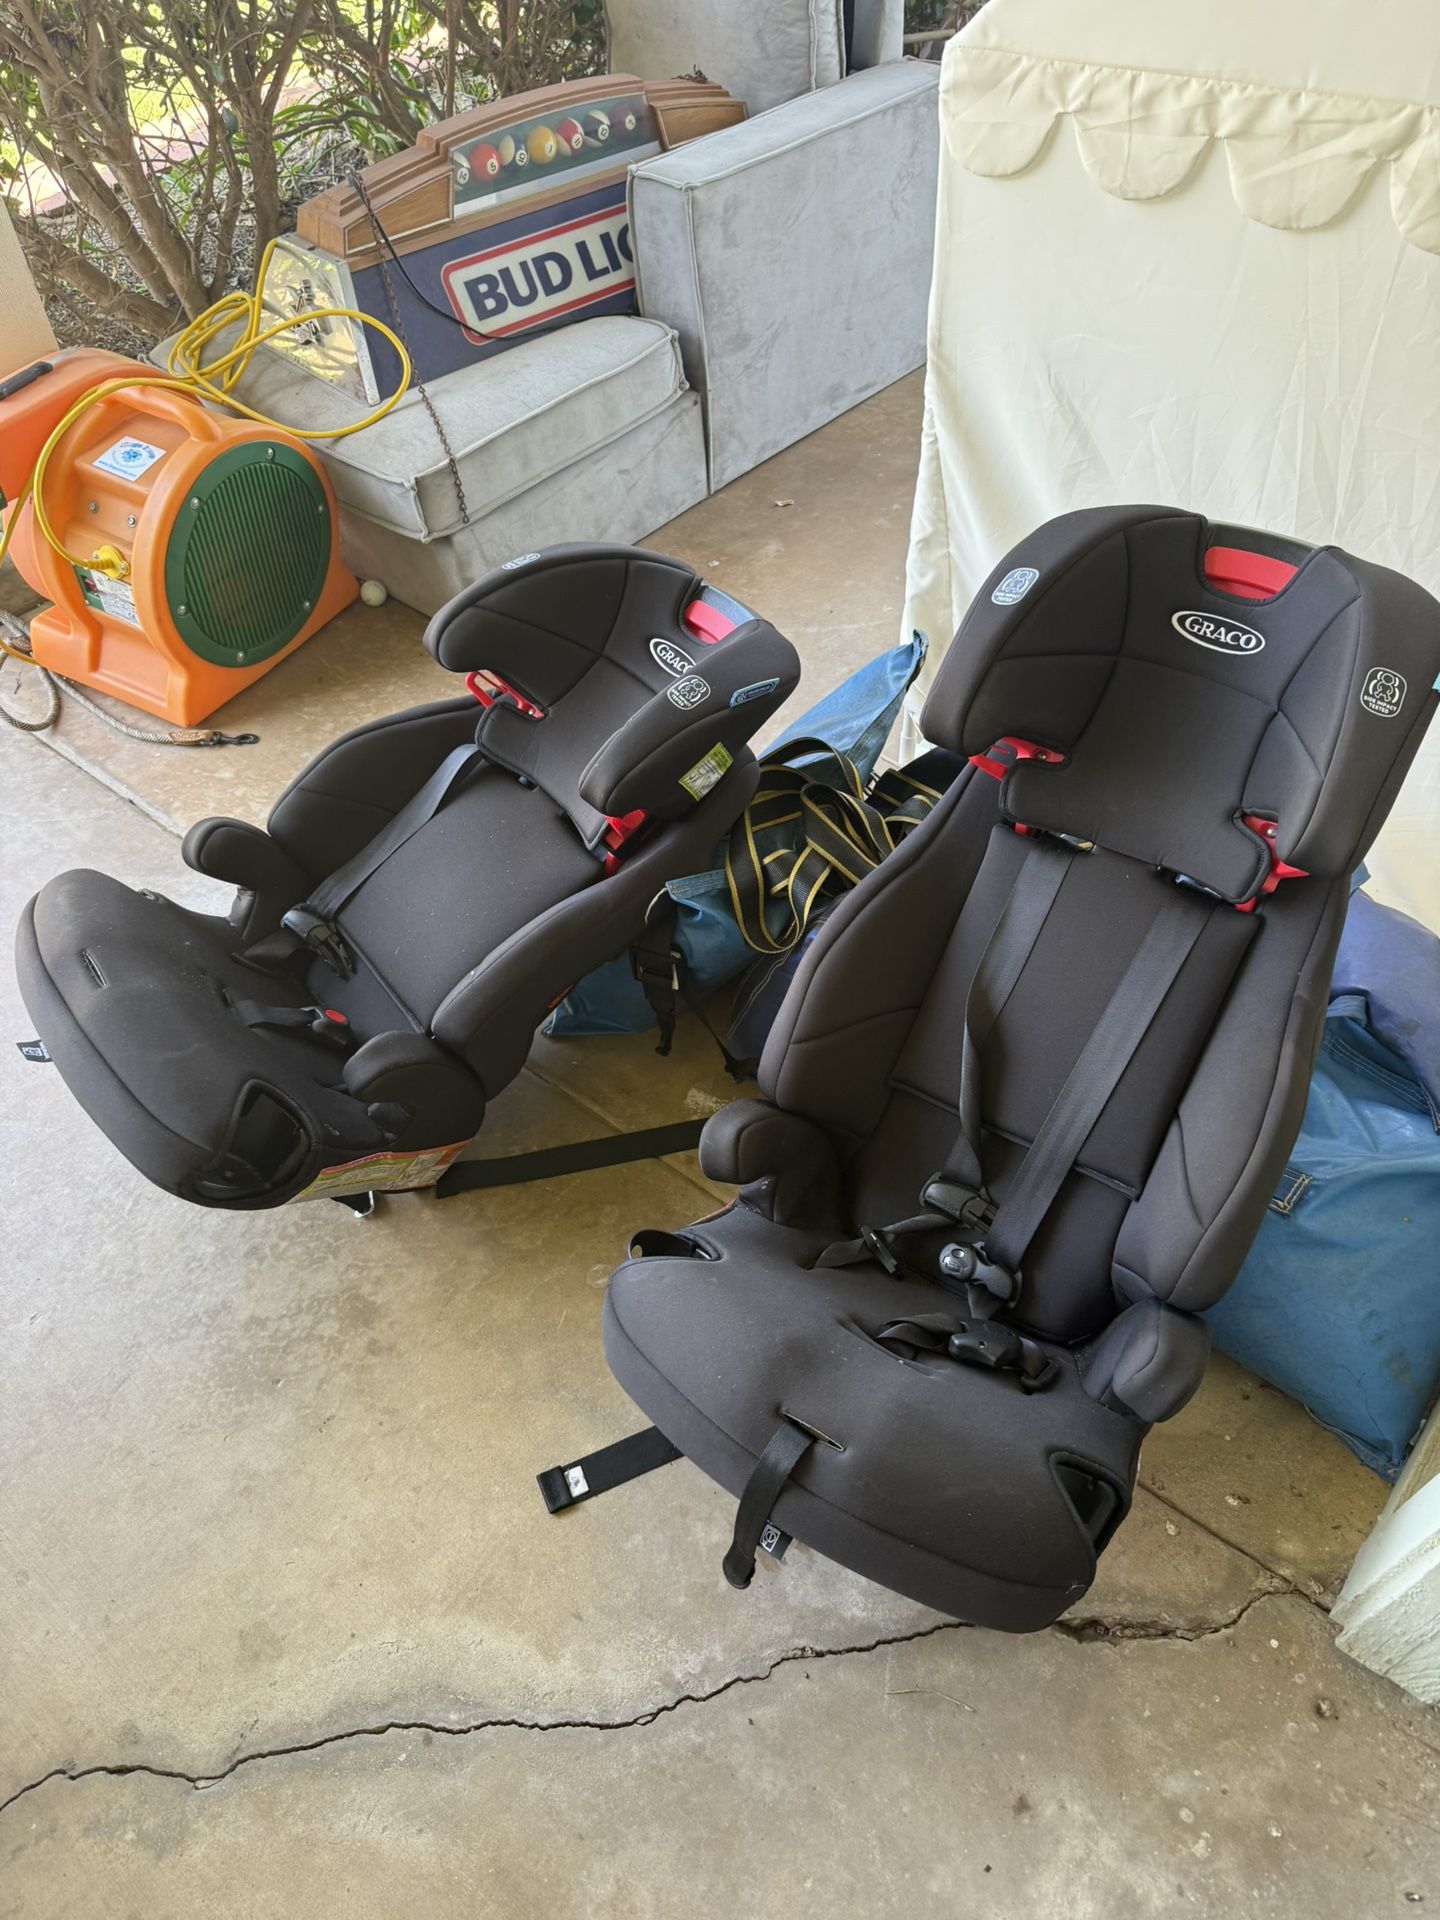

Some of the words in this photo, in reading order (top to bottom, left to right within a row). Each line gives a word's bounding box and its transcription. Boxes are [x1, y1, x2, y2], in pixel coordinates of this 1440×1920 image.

[600, 126, 608, 137] 12
[518, 152, 526, 163] 10
[458, 171, 467, 181] 14
[464, 252, 573, 321] BUD
[1185, 616, 1257, 649] GRACO
[1363, 695, 1376, 704] SIDE
[1376, 699, 1397, 712] IMPACT
[1369, 702, 1389, 714] TESTED
